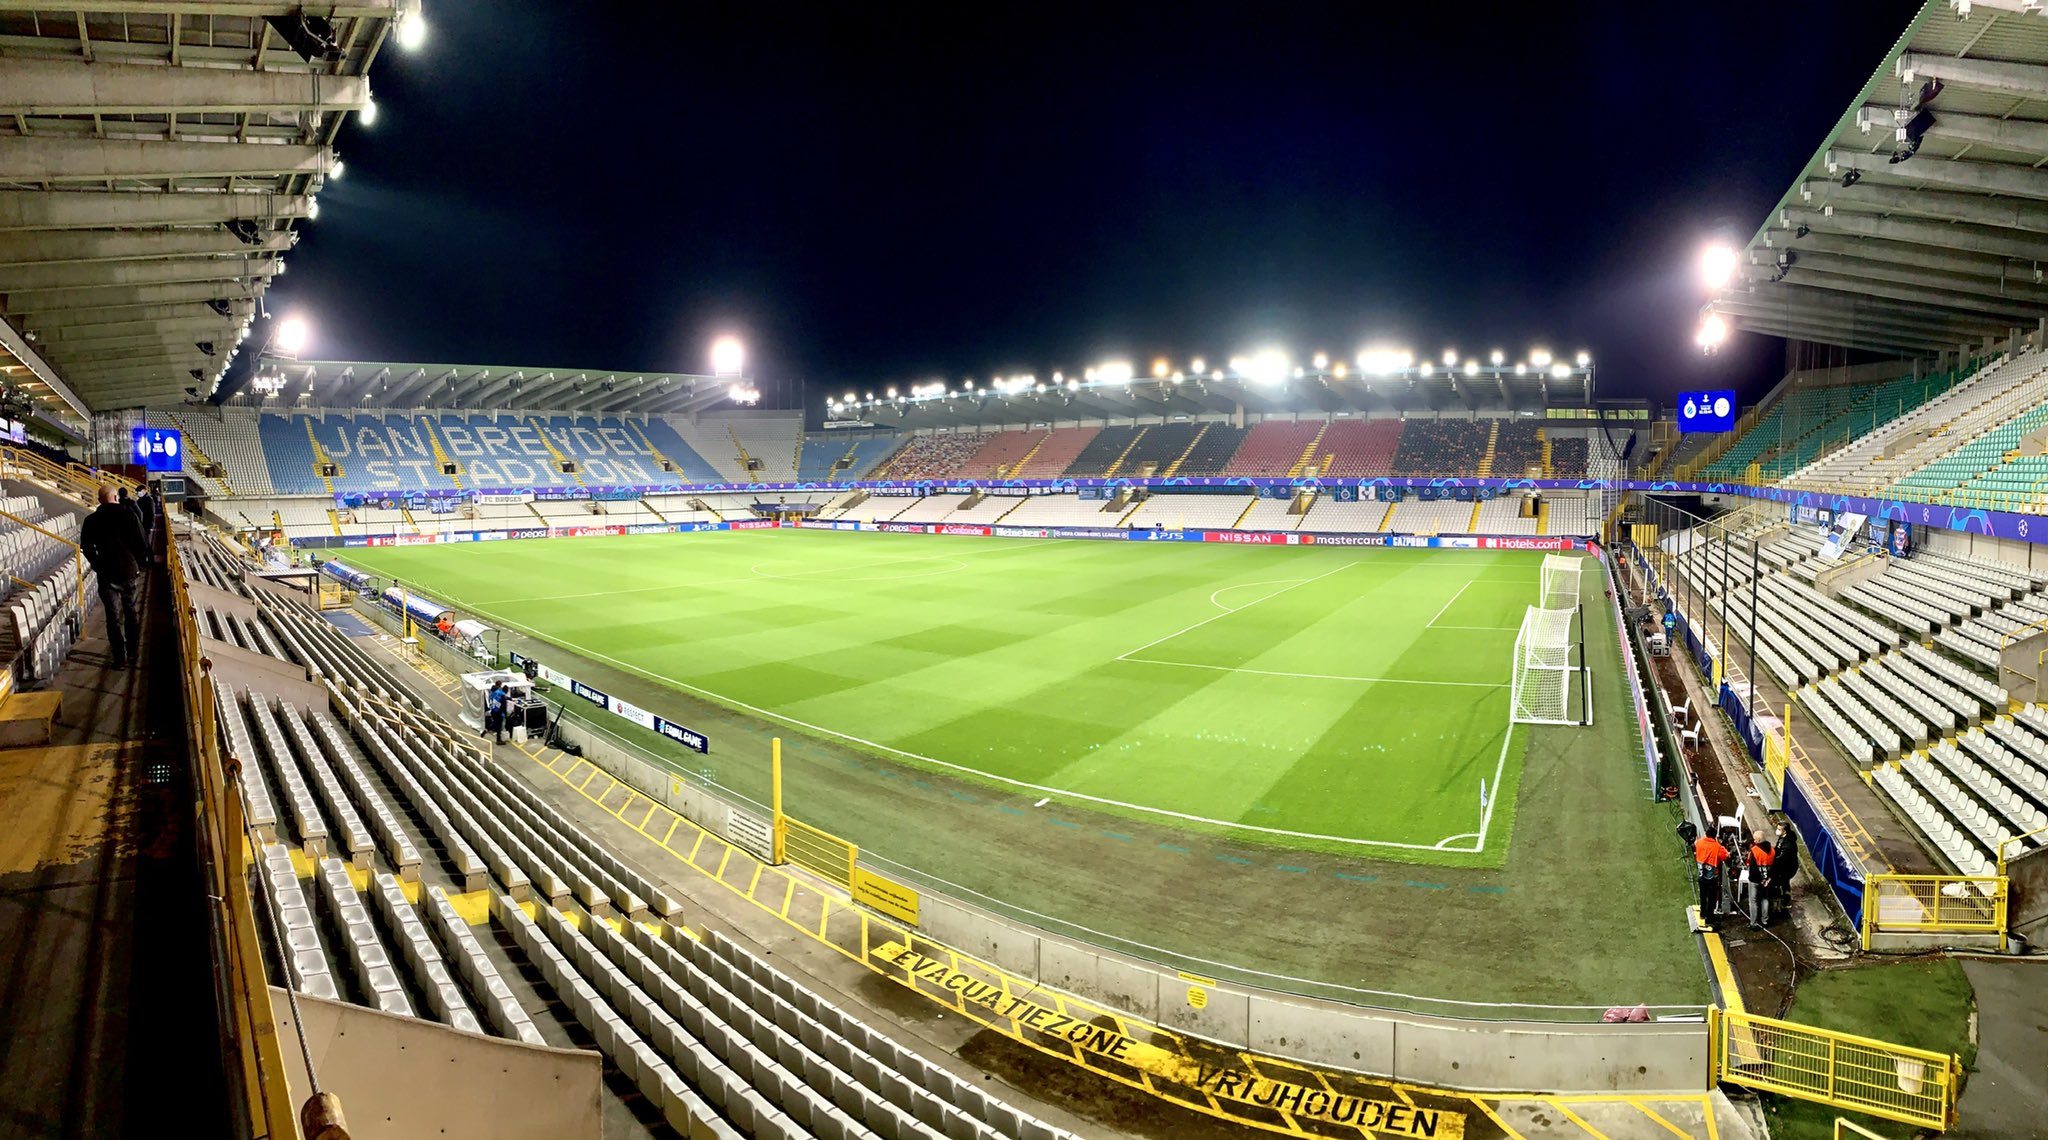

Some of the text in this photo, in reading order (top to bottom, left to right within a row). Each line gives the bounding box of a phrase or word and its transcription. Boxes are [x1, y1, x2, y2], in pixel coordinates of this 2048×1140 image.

[322, 426, 654, 457] JAN BREYDEL
[583, 527, 620, 536] Santander
[629, 525, 668, 535] Heineken
[890, 524, 908, 532] pepsi
[948, 525, 984, 535] Santander
[996, 527, 1040, 538] Heineken
[521, 530, 546, 539] pepsi
[1159, 532, 1184, 540] PS5
[1219, 533, 1272, 543] NISSAN
[383, 536, 430, 546] Hoels.com
[1316, 536, 1384, 545] mastercard
[1393, 536, 1429, 547] GAZPROM
[1500, 538, 1560, 549] Hotels.com
[591, 690, 605, 705] GAME
[624, 706, 644, 722] RESPECT
[665, 724, 702, 748] EQUAL GAME
[892, 950, 1137, 1059] EVACUATIEZONE
[1197, 1064, 1439, 1137] VRIJHOUDEN
